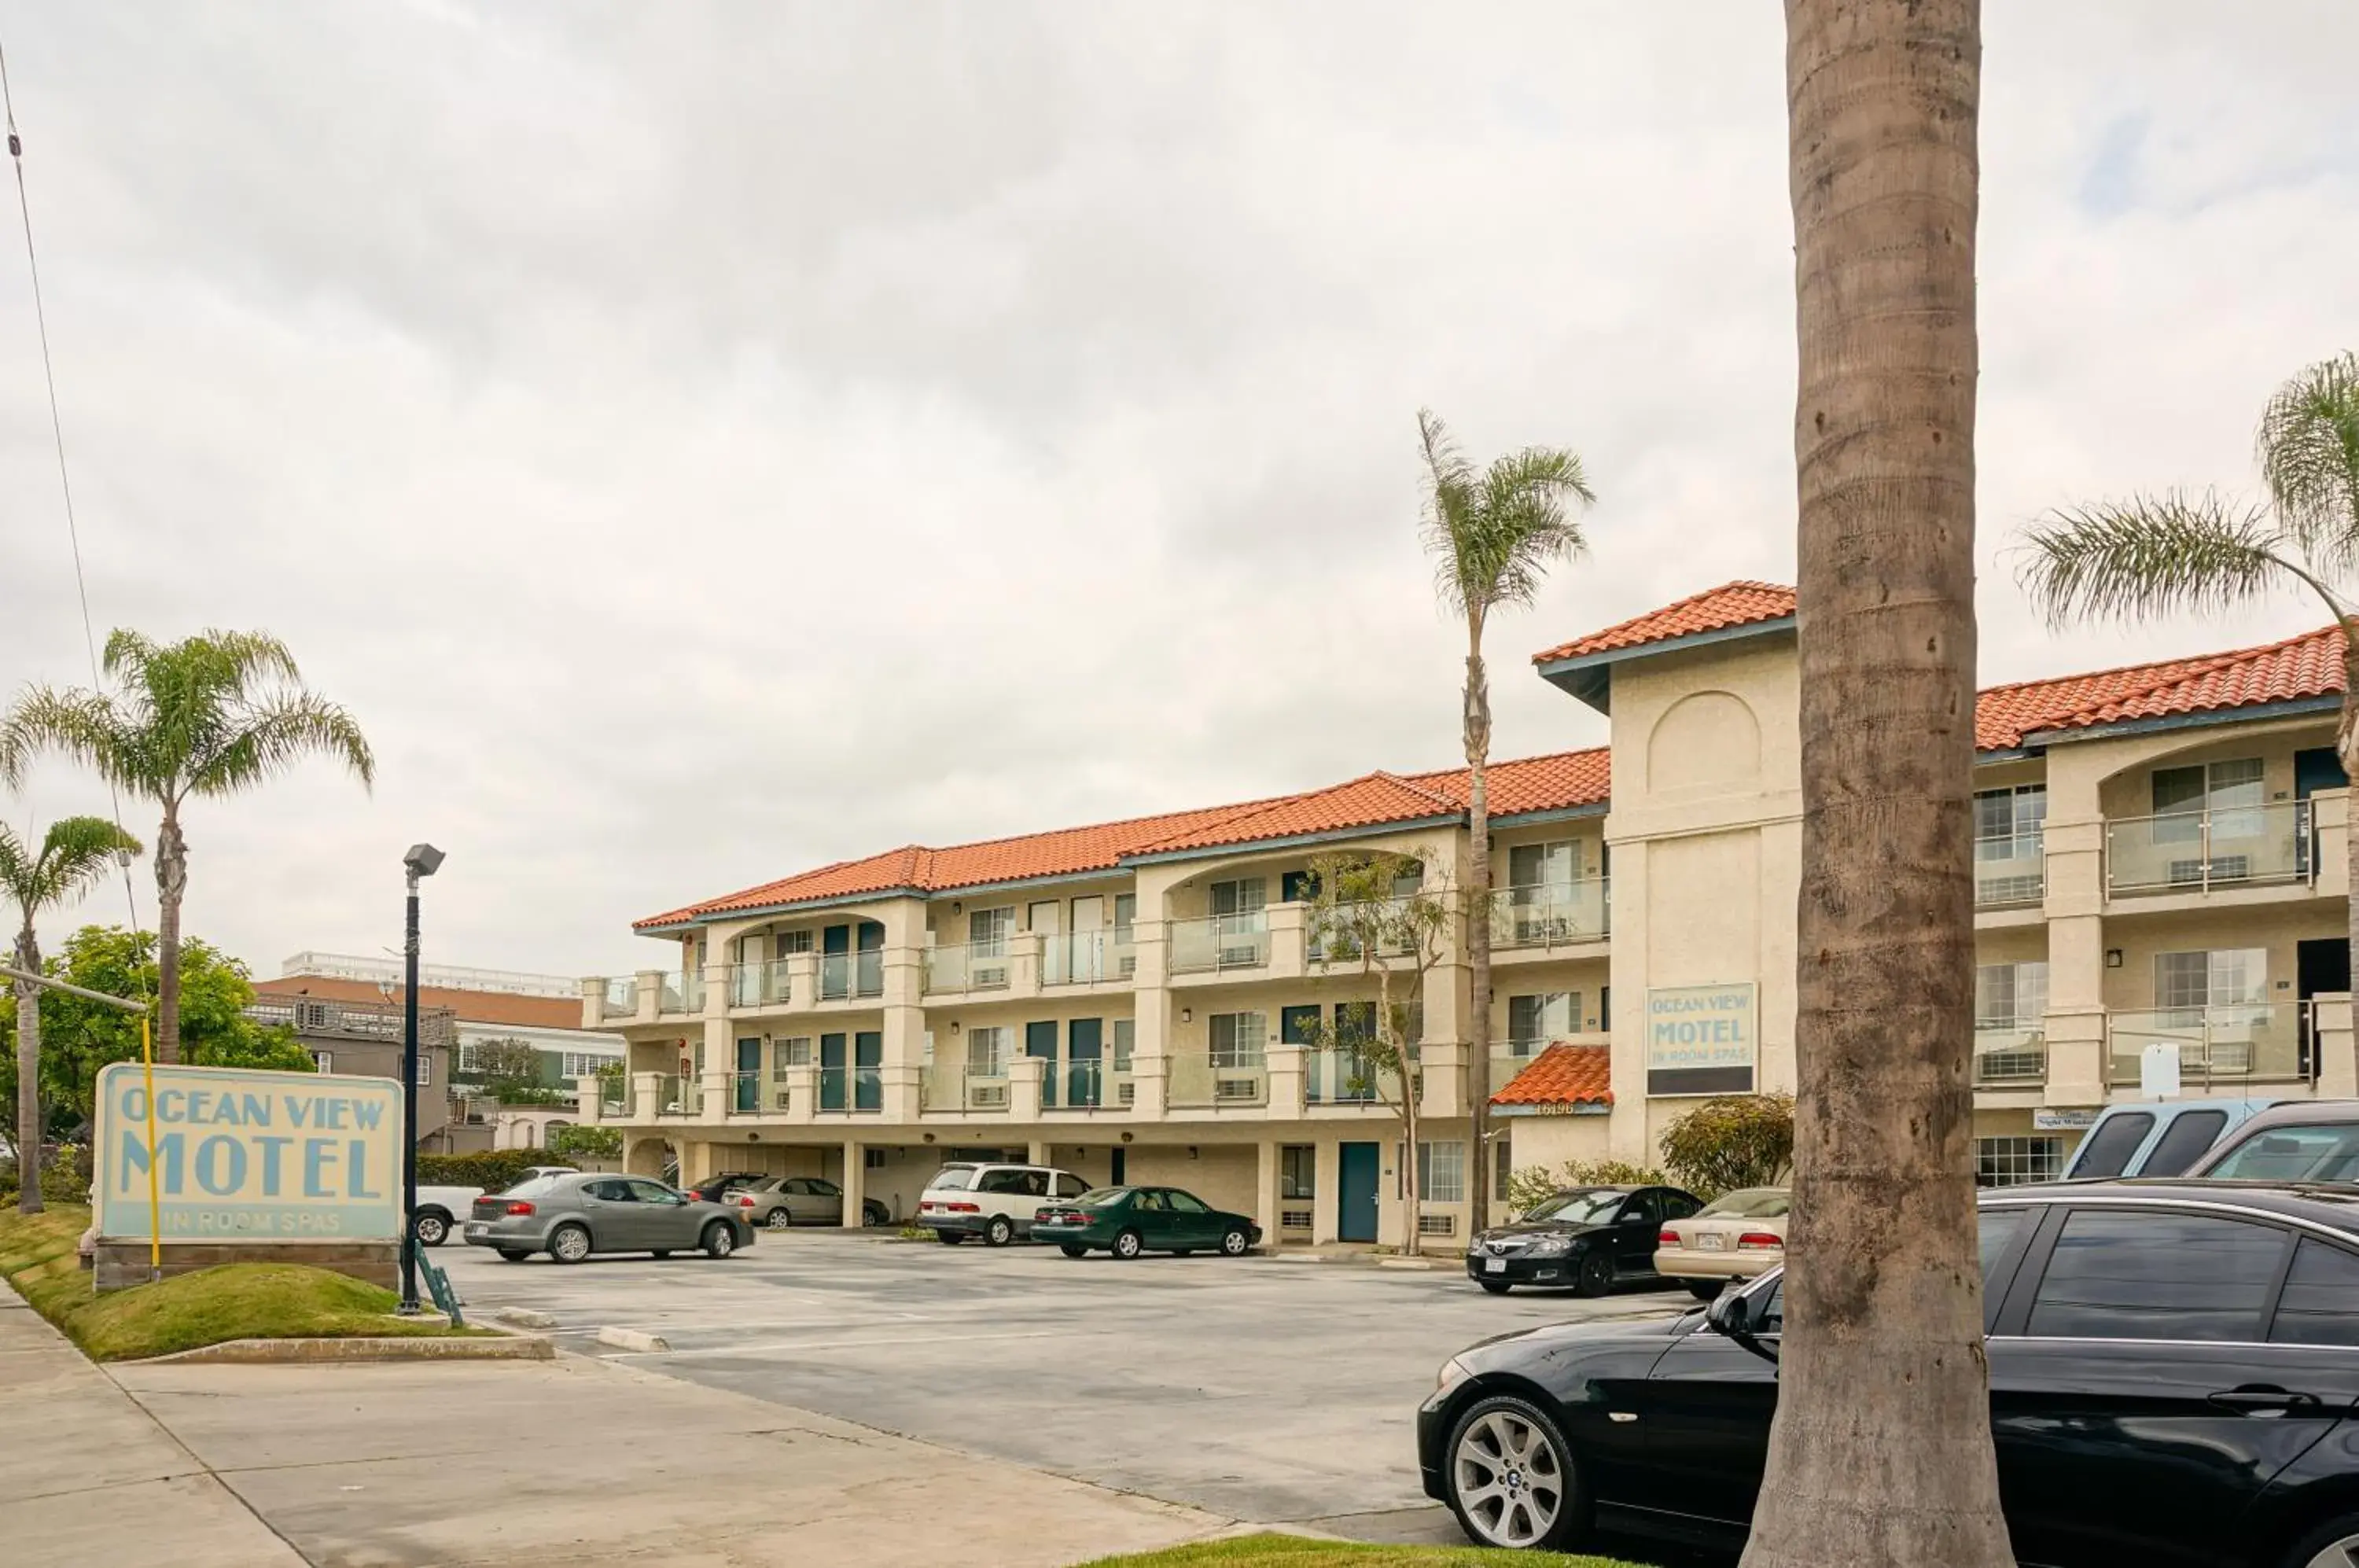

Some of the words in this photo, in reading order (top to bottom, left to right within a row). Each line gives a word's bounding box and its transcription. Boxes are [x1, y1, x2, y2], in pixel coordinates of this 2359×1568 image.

[1653, 999, 1704, 1014] OCEAN
[1709, 995, 1749, 1010] VIEW
[1655, 1020, 1746, 1045] MOTEL
[121, 1088, 271, 1126] OCEAN
[285, 1095, 385, 1131] VIEW
[121, 1131, 381, 1199] MOTEL
[163, 1211, 189, 1229] IN
[199, 1211, 273, 1232] ROOM
[281, 1213, 341, 1232] SPAS
